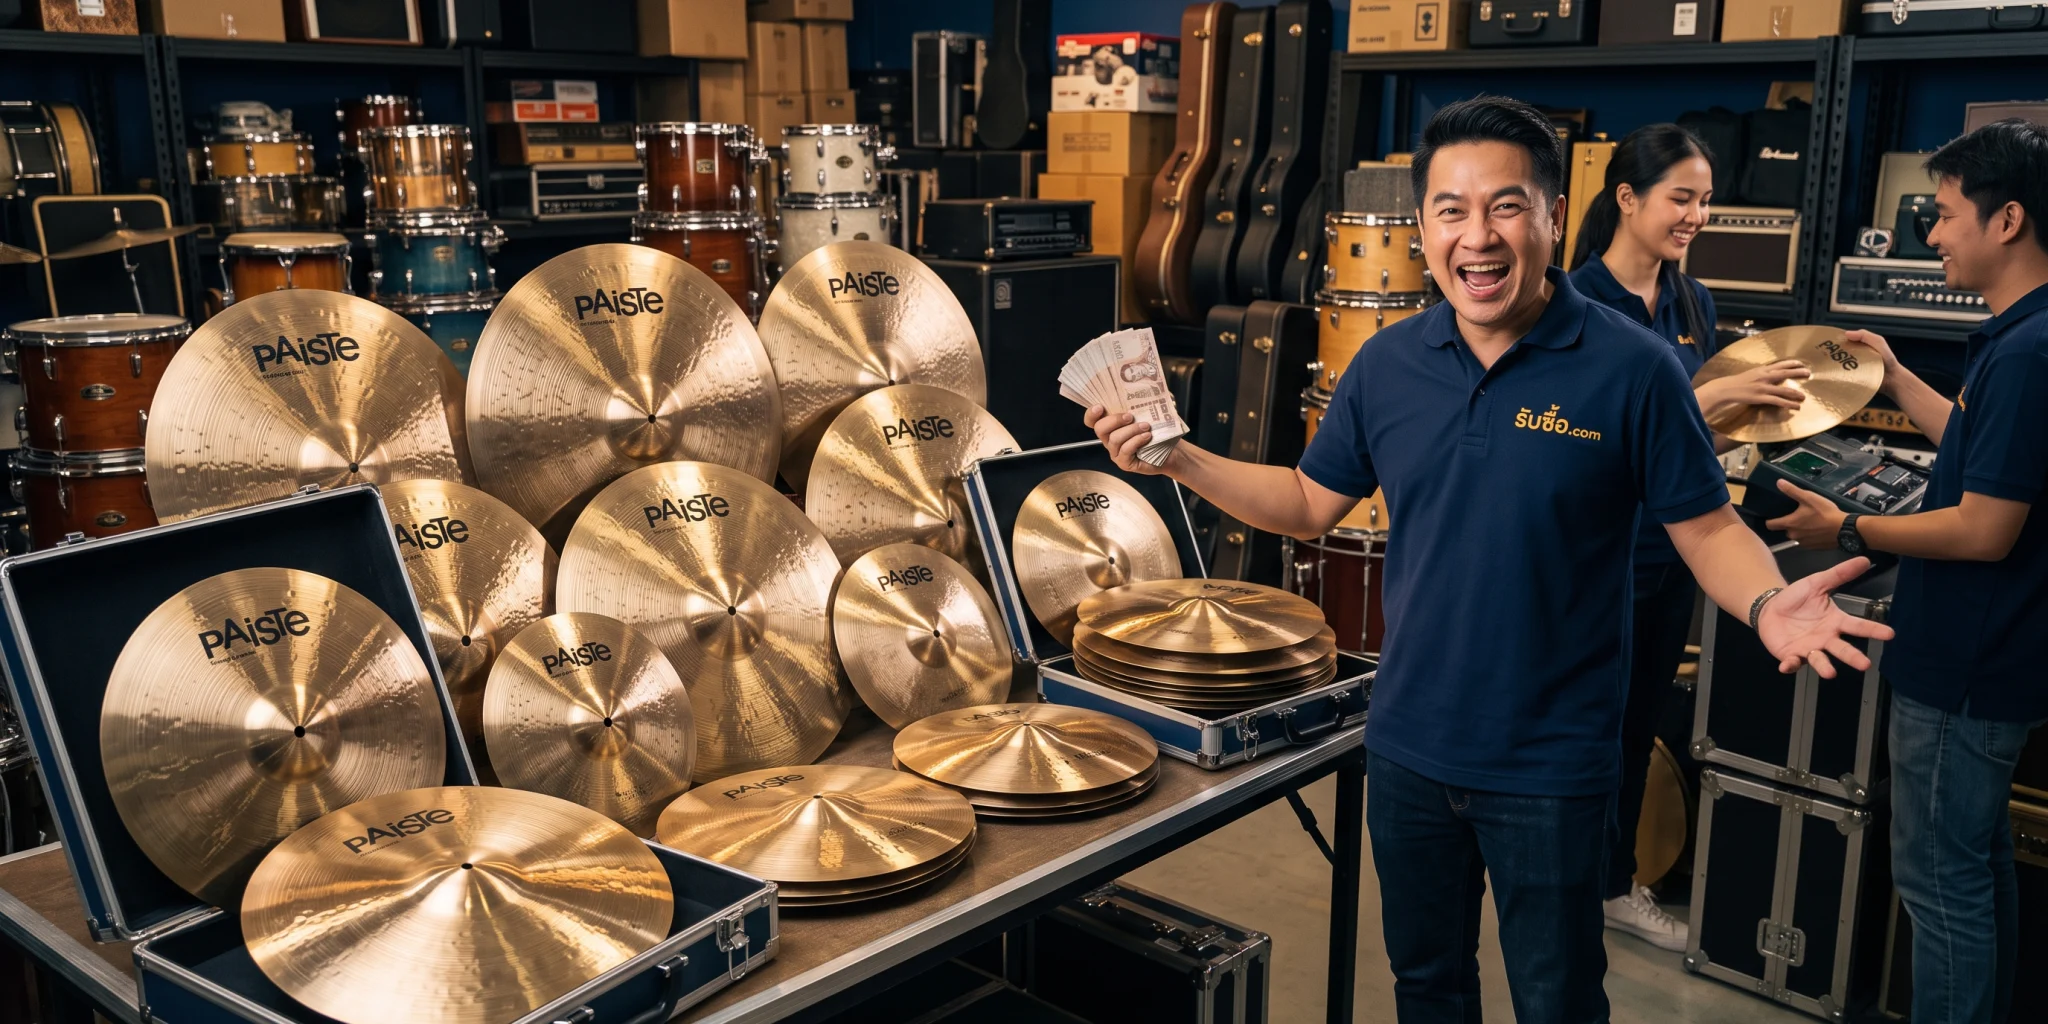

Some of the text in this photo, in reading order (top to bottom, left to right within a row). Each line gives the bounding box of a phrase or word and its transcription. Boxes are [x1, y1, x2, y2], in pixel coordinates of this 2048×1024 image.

[1514, 404, 1601, 441] รับซื้อ.com
[394, 516, 469, 551] AiSTe
